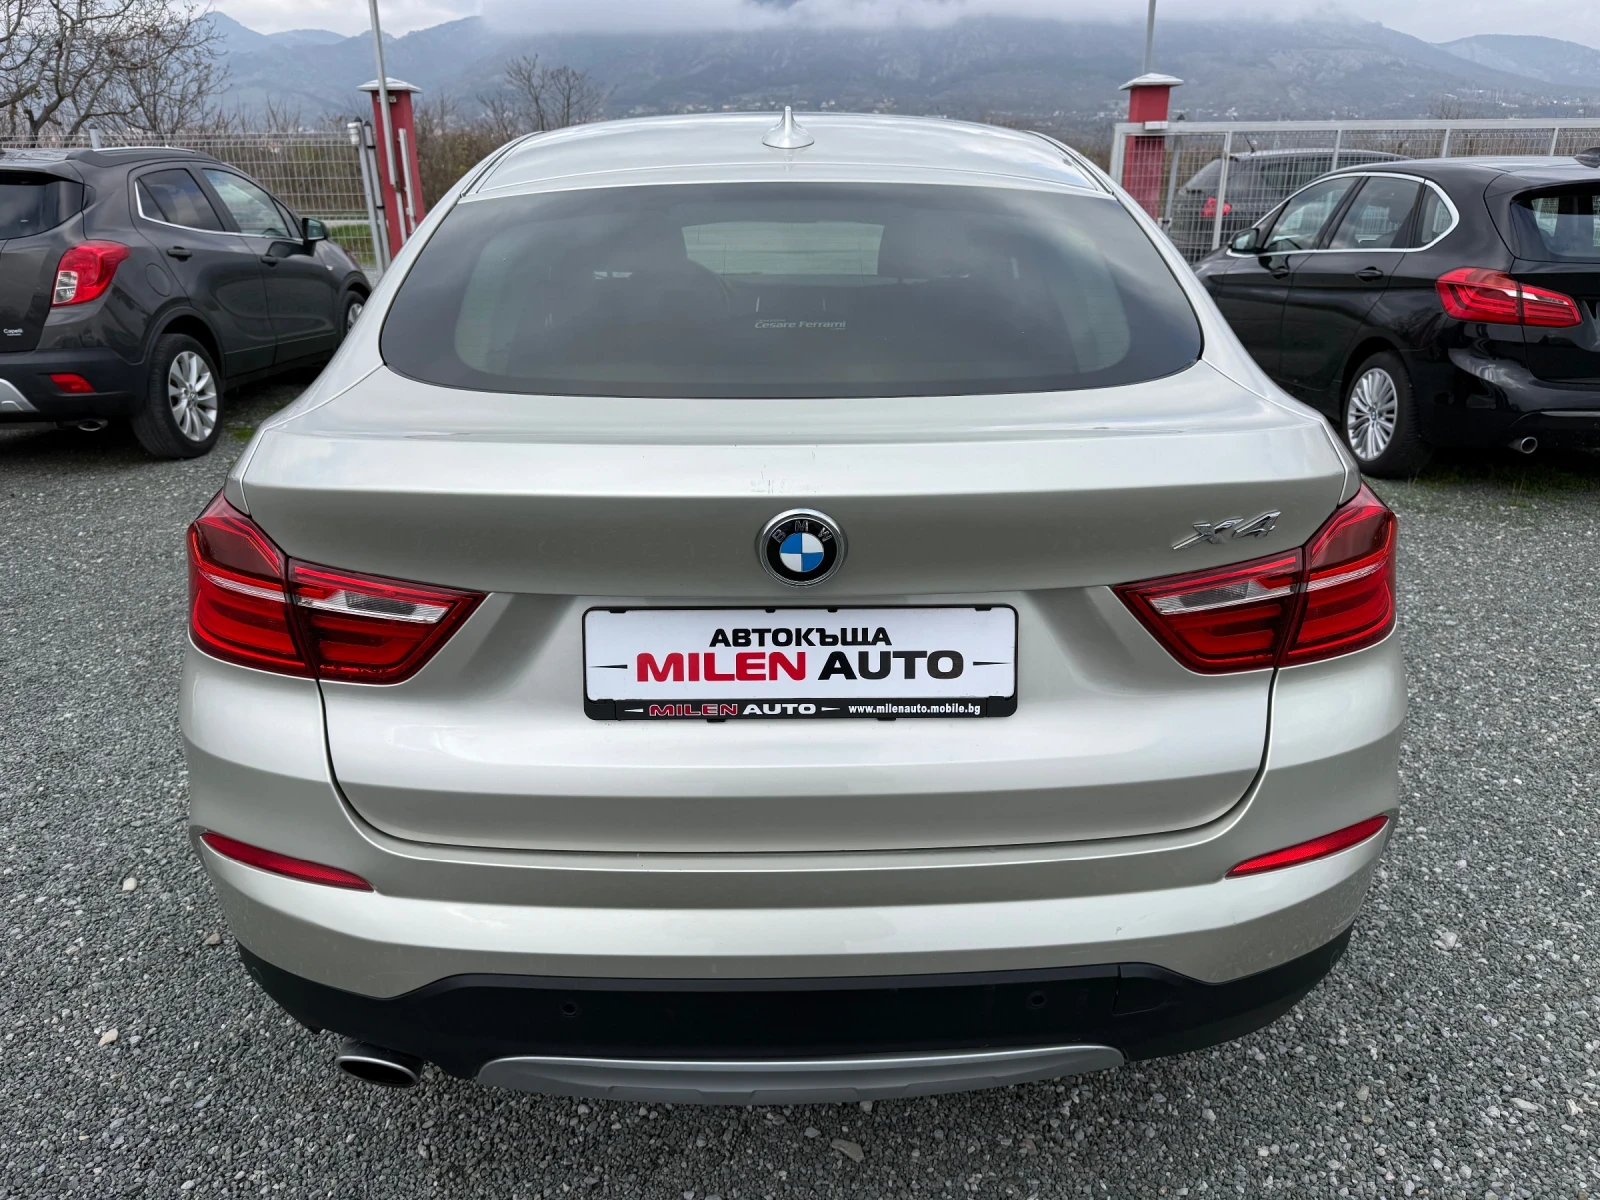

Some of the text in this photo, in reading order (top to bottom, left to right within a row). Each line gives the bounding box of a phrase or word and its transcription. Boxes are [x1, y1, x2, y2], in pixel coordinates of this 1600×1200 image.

[754, 320, 796, 329] Cesare
[771, 520, 833, 544] BMW
[1171, 510, 1281, 550] X4
[636, 650, 964, 682] MILEN AUTO
[649, 703, 981, 716] MILEN AUTO www.milenauto.mobile.bg
